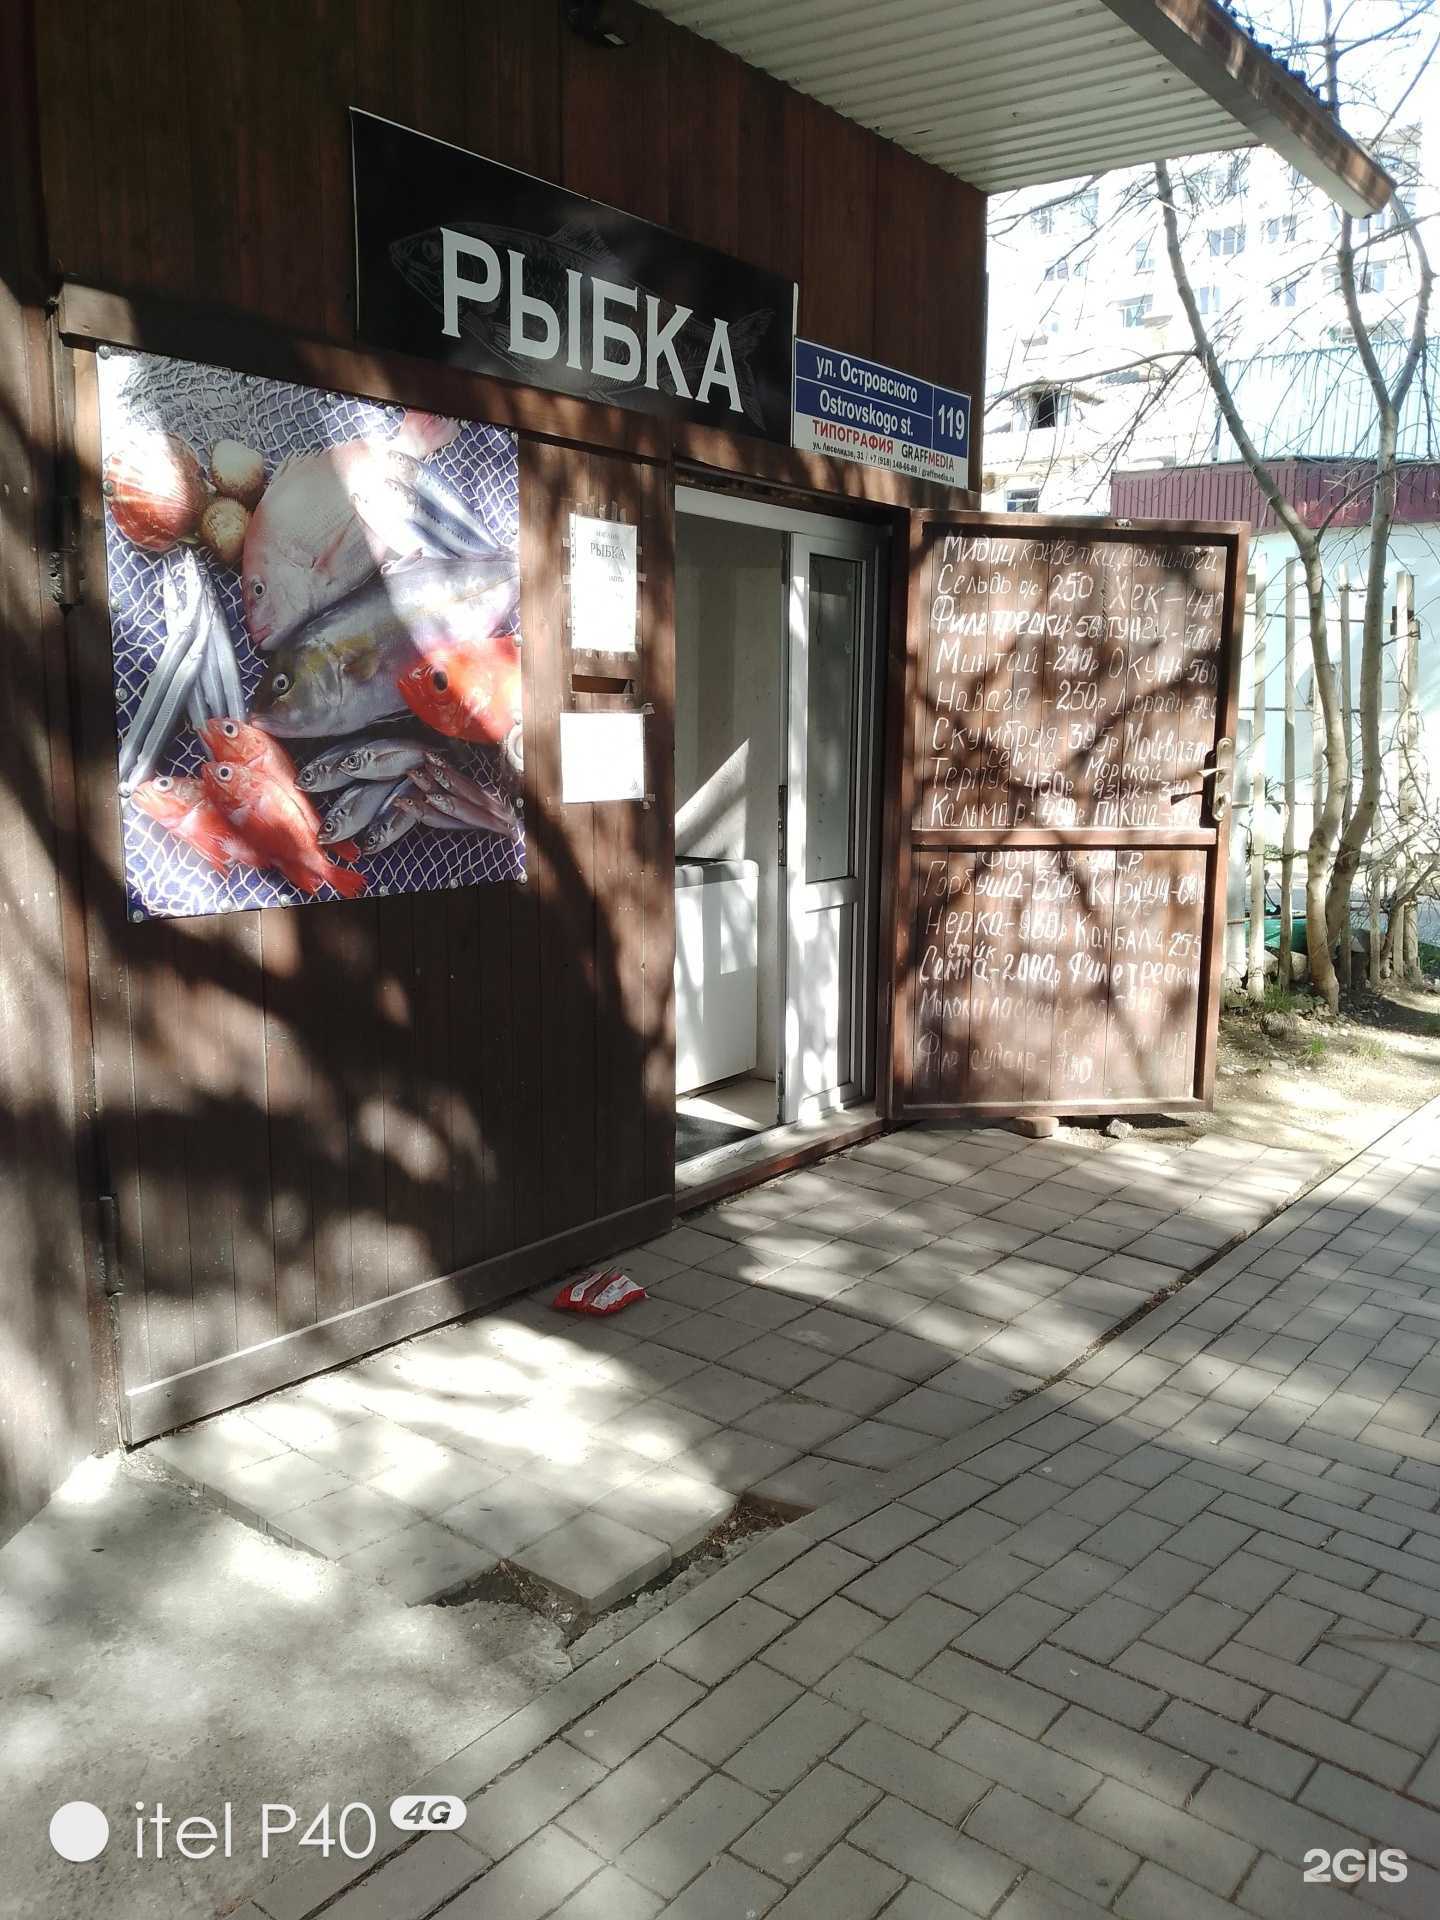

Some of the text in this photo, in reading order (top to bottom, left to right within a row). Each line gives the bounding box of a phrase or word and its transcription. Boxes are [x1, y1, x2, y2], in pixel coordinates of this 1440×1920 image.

[440, 226, 744, 413] РЫБКА
[816, 355, 917, 403] ул. Островского
[820, 389, 914, 437] Ostrovskogo st.
[938, 404, 965, 441] 119
[812, 419, 955, 472] ТИПОГРАФИЯ GRAFFMEDIA
[590, 542, 626, 561] РЫБКА
[937, 563, 1012, 595] Сельдь
[936, 637, 1039, 674] Минтай
[936, 680, 1031, 713] Навага
[931, 791, 1026, 828] Кальмар
[922, 860, 1023, 898] Горбуша
[925, 904, 1003, 946] Нерка
